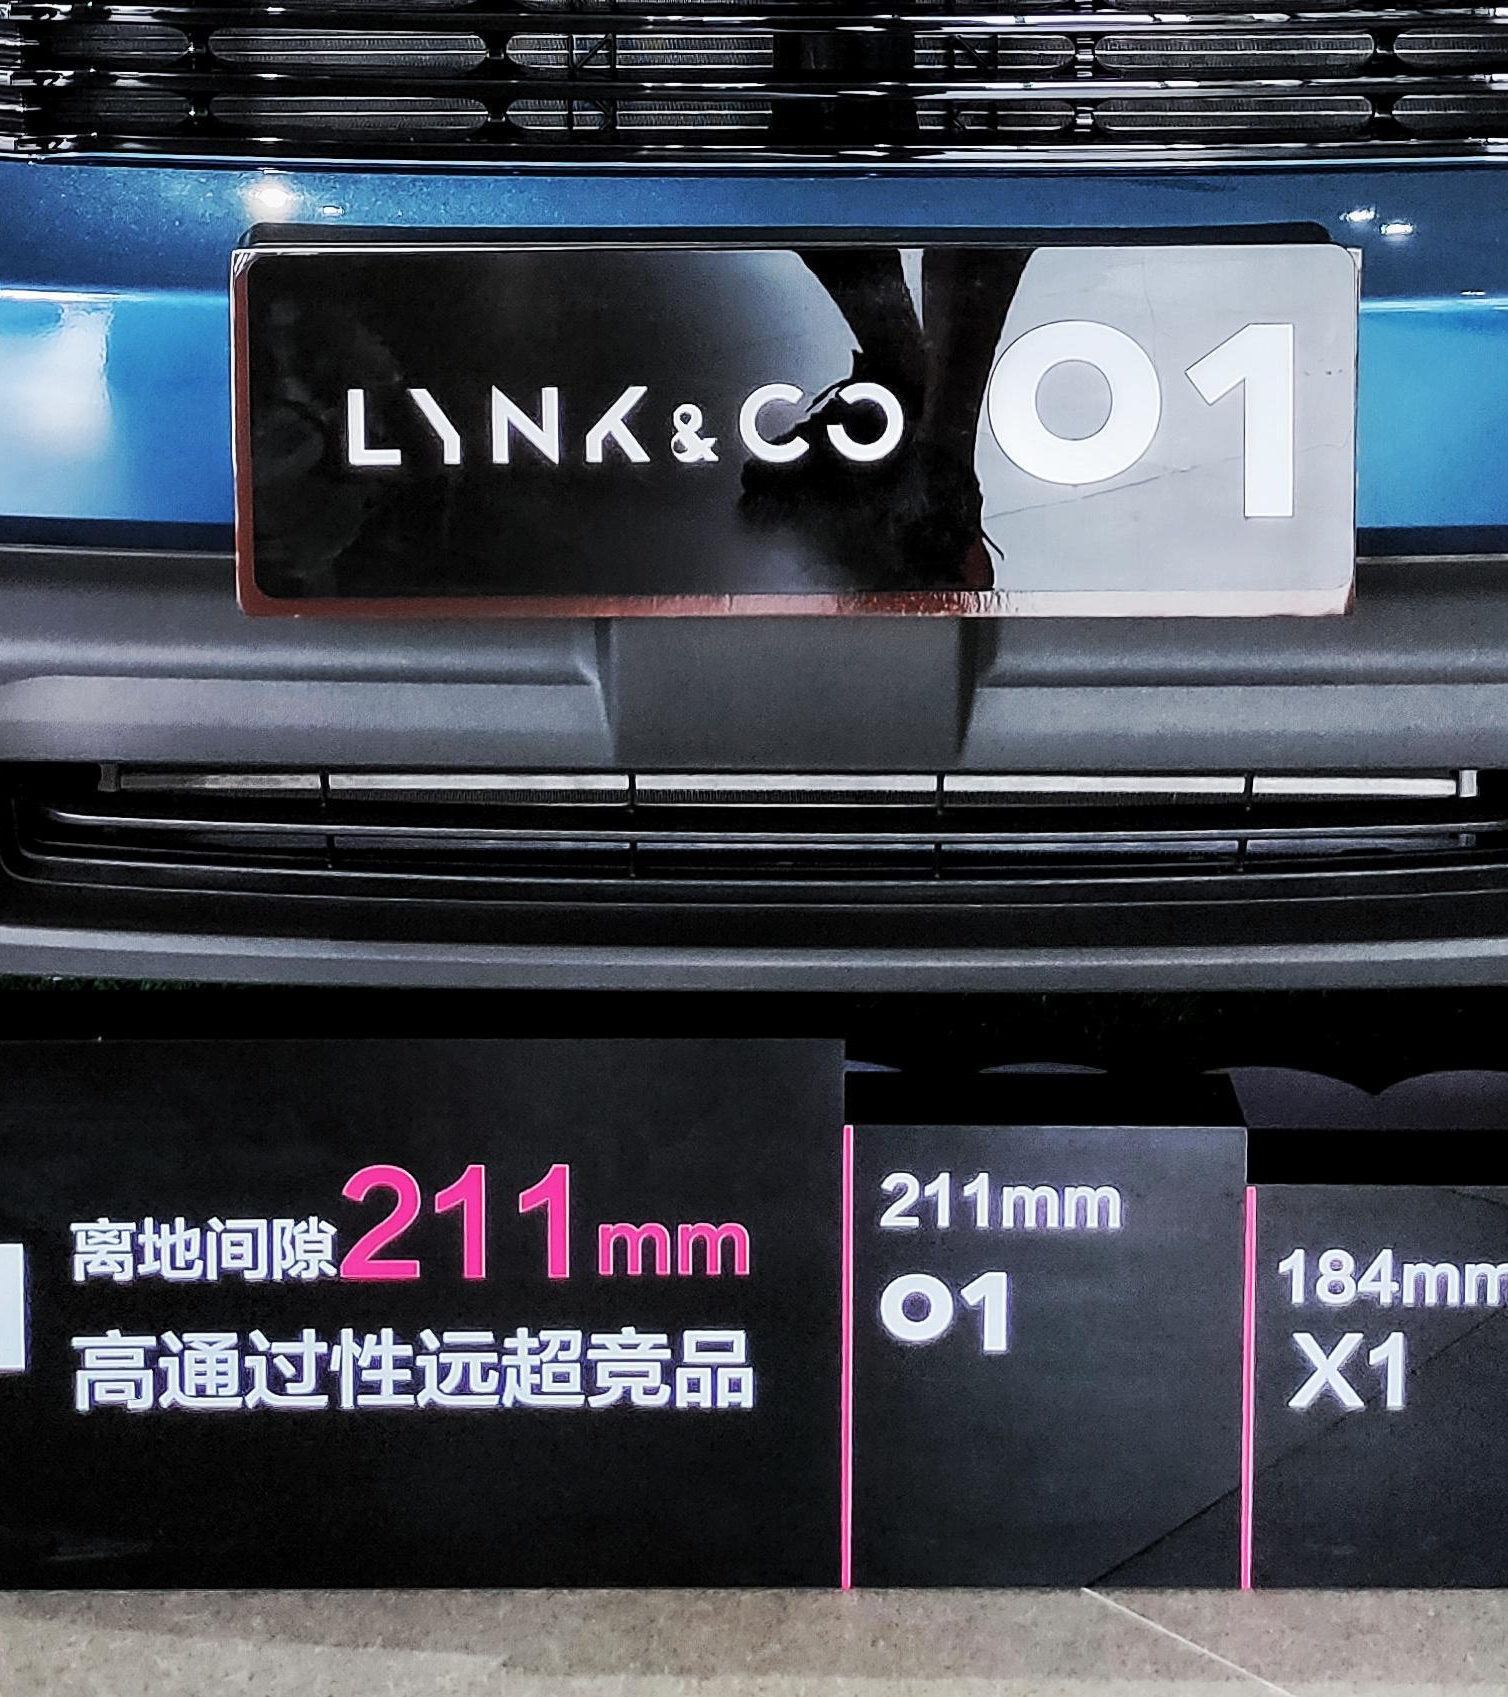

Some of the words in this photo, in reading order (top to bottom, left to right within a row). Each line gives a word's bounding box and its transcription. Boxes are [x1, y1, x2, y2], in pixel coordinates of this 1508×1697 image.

[345, 379, 906, 467] LYNK&CO
[985, 317, 1299, 520] 01
[68, 1216, 340, 1285] 离地间隙
[338, 1162, 754, 1280] 211mm
[876, 1171, 1124, 1234] 211mm
[876, 1269, 1011, 1354] 01
[70, 1324, 758, 1412] 高通过性远超竞品
[1286, 1328, 1413, 1413] X1
